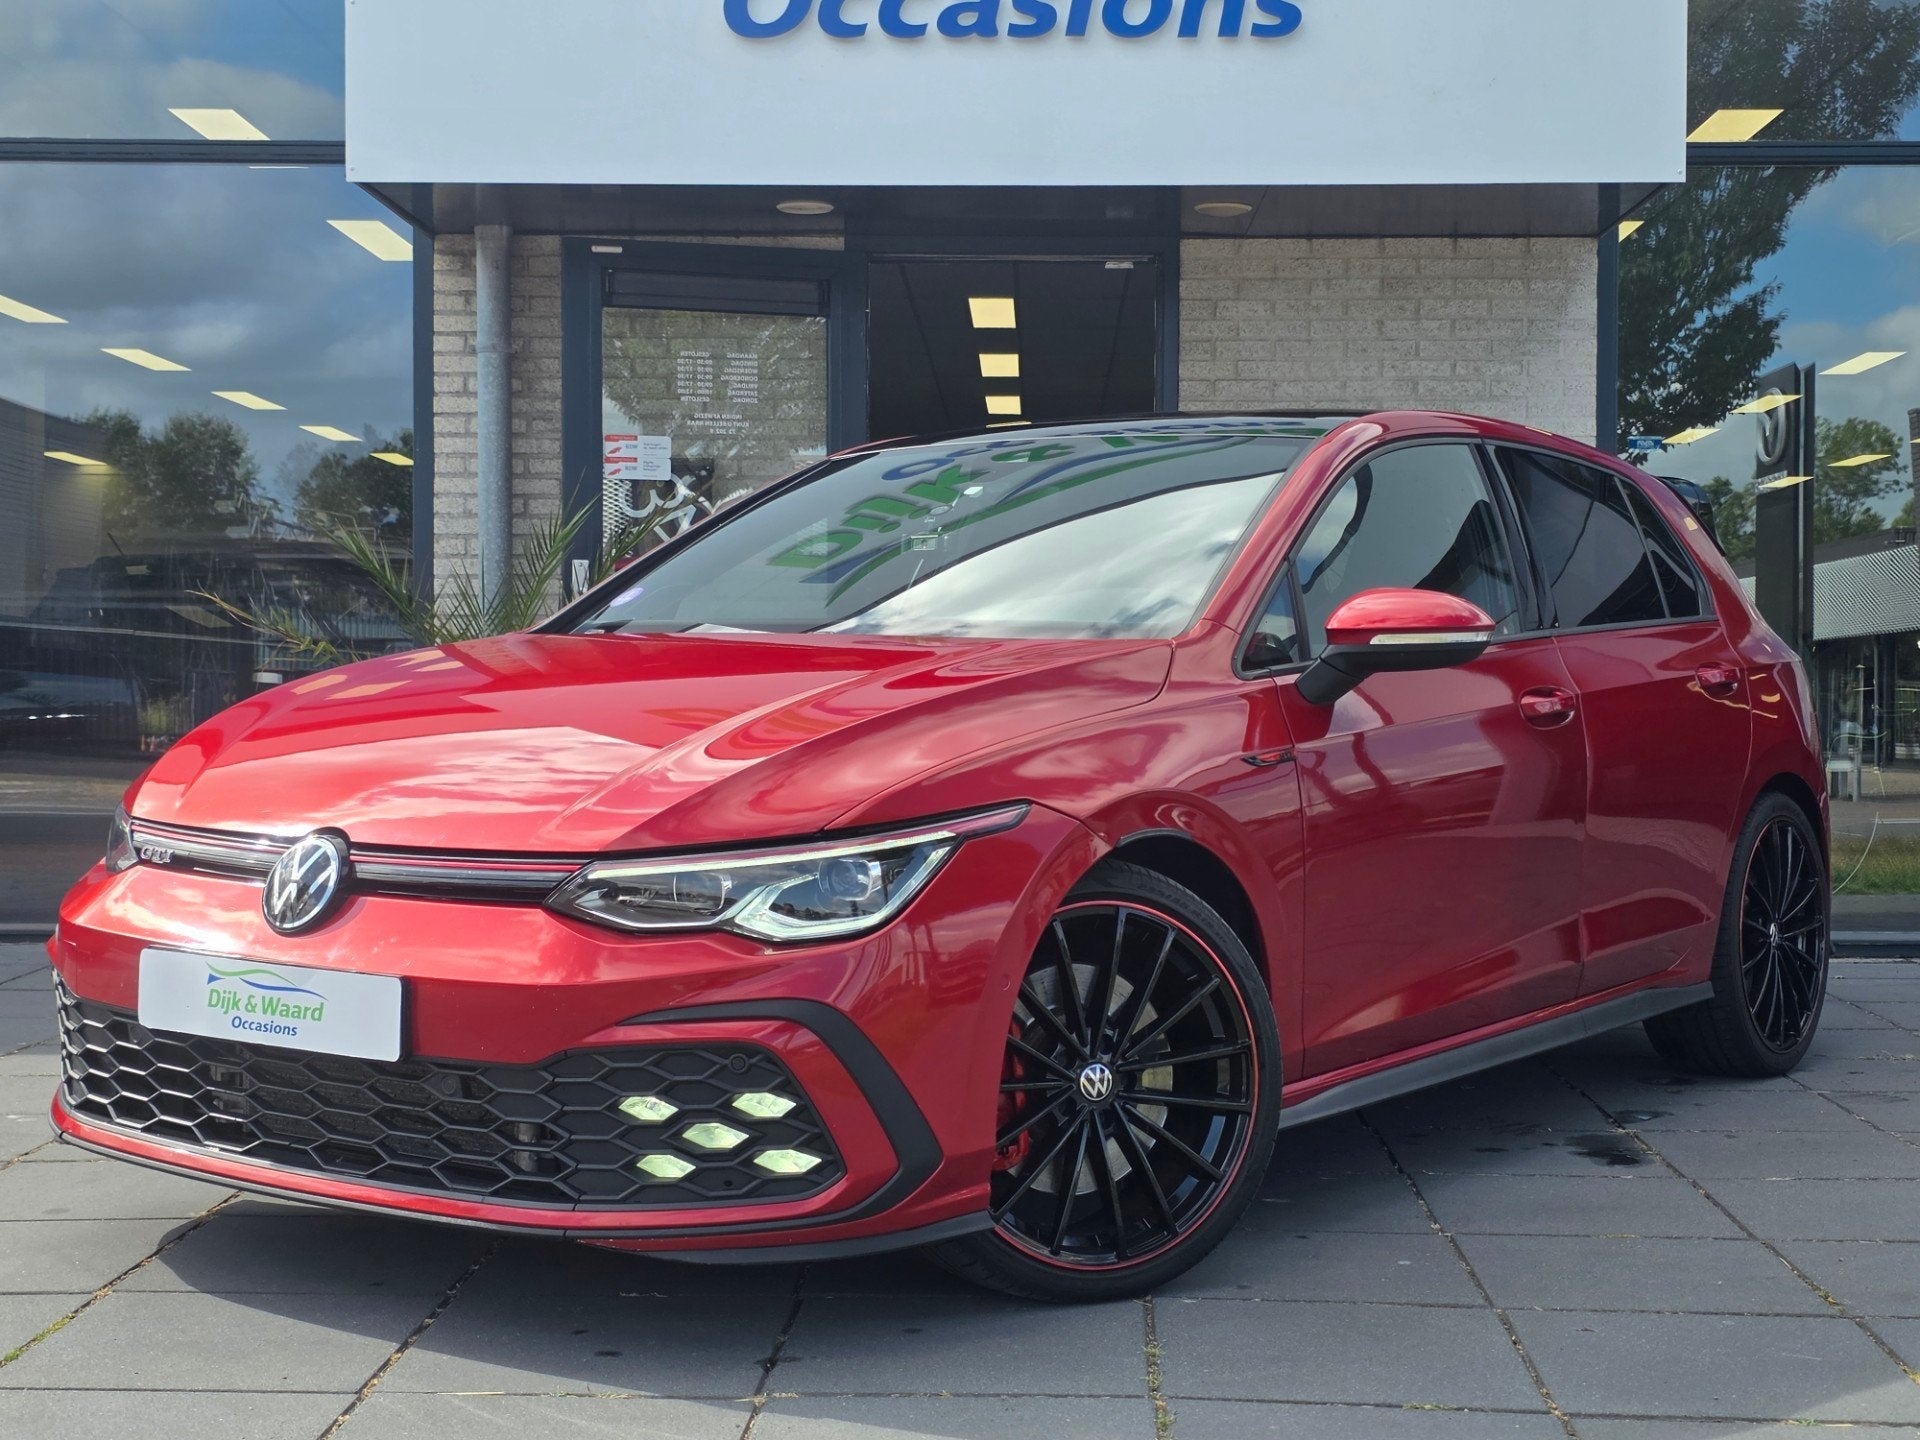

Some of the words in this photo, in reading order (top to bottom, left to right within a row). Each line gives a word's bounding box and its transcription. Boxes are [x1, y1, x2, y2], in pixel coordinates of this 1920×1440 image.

[208, 988, 242, 1015] Dijk
[244, 994, 258, 1013] &
[261, 995, 325, 1022] Waard
[231, 1015, 298, 1036] Occasions
